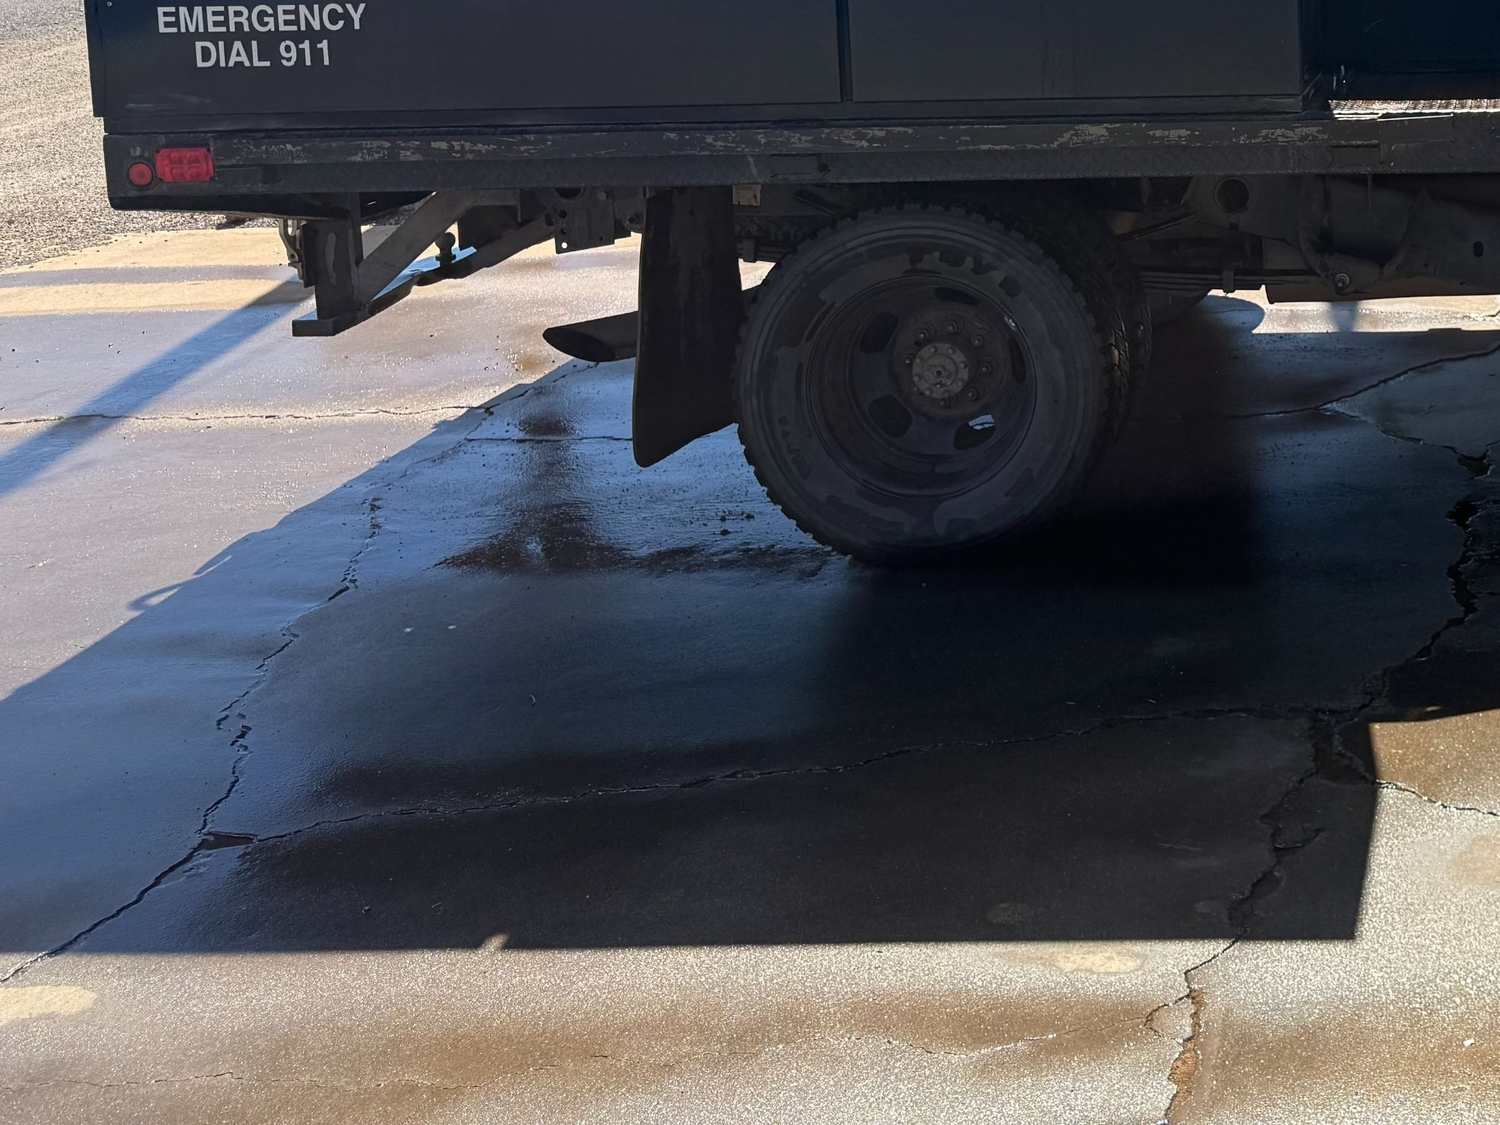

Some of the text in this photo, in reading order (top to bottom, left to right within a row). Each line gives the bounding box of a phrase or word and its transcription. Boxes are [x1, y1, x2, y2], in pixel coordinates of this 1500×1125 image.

[157, 2, 366, 33] EMERGENCY
[195, 39, 330, 68] DIAL 911
